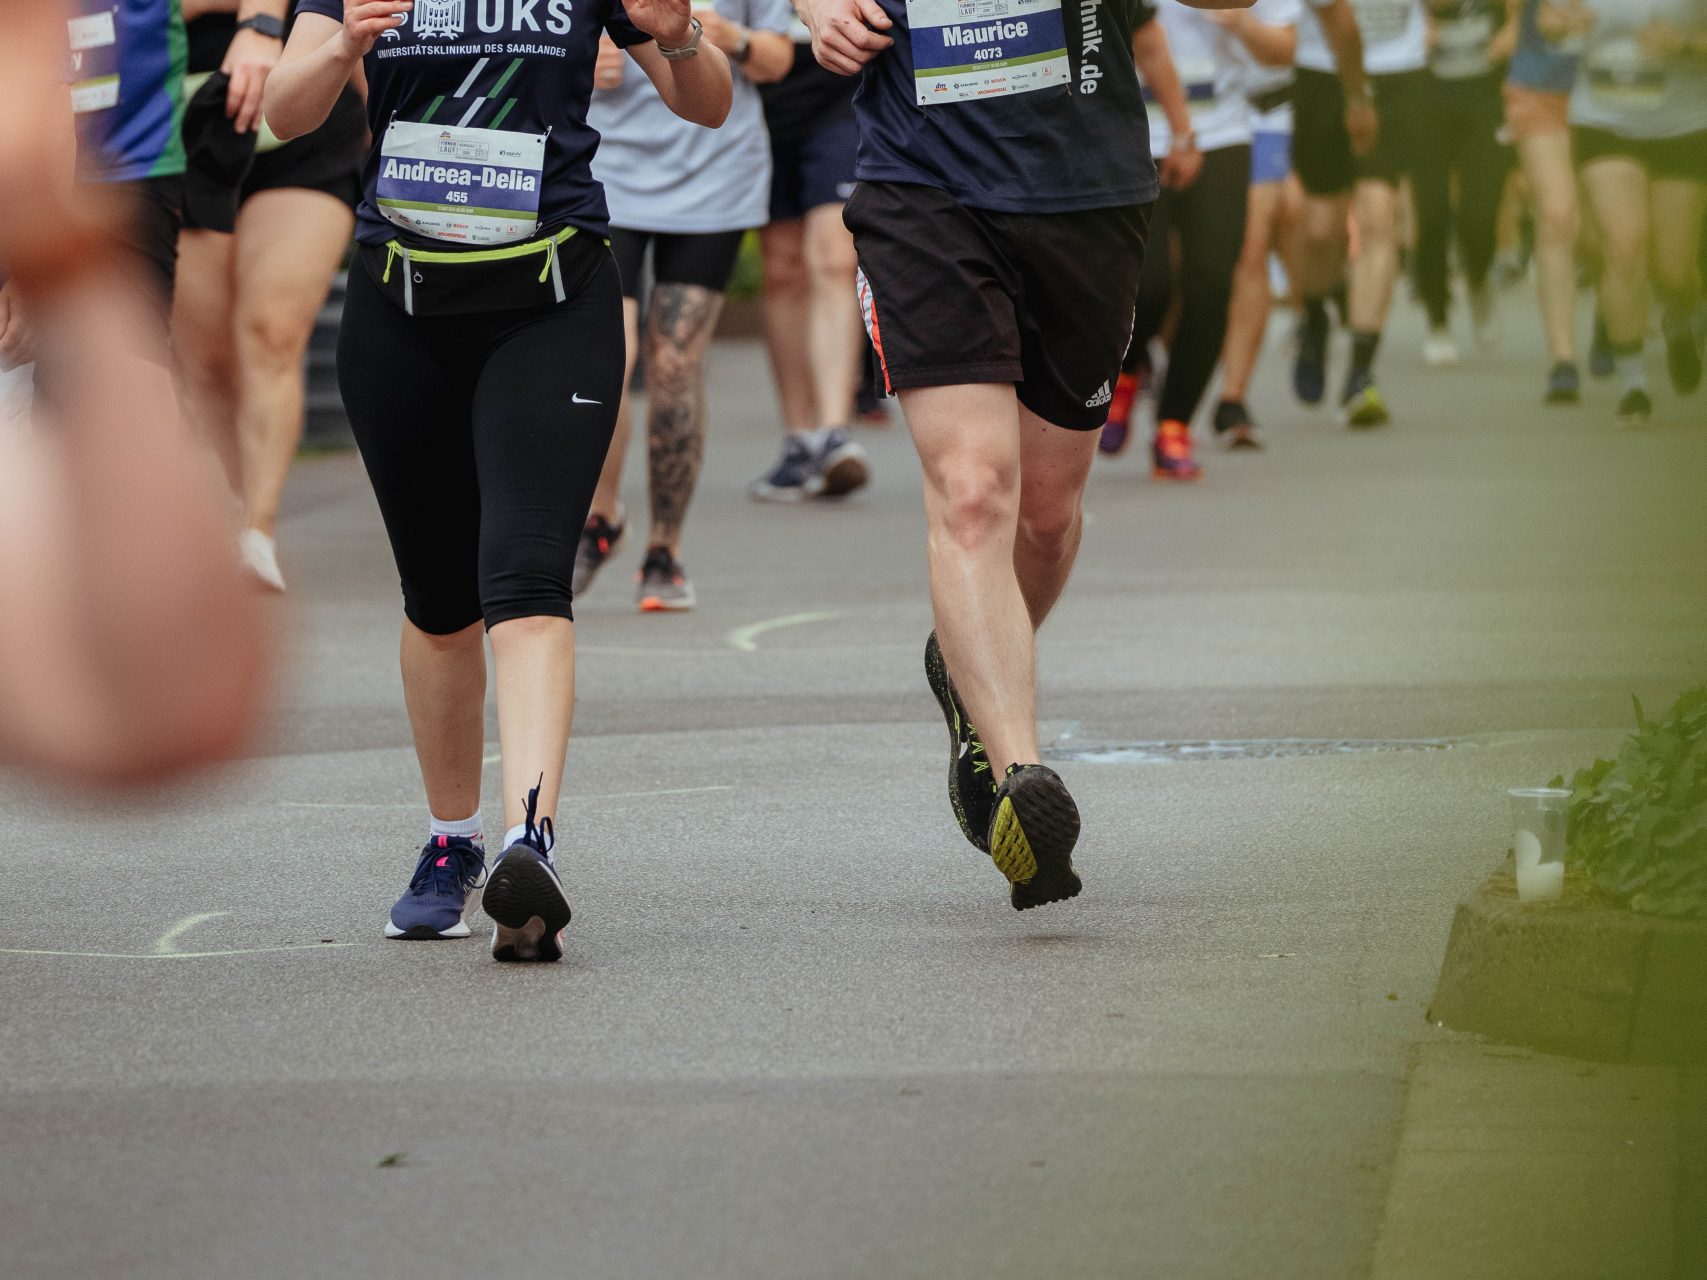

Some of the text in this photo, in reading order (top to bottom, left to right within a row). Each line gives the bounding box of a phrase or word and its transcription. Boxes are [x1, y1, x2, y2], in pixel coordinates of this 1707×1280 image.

[942, 20, 1028, 47] Maurice
[377, 43, 567, 59] UNIVERSITÄTSKLINIKUM DES SAARLANDES
[974, 46, 1003, 61] 4073
[440, 146, 455, 154] LAUF
[383, 159, 535, 192] Andreea-Delia
[445, 190, 468, 203] 455
[1085, 392, 1112, 408] adidas
